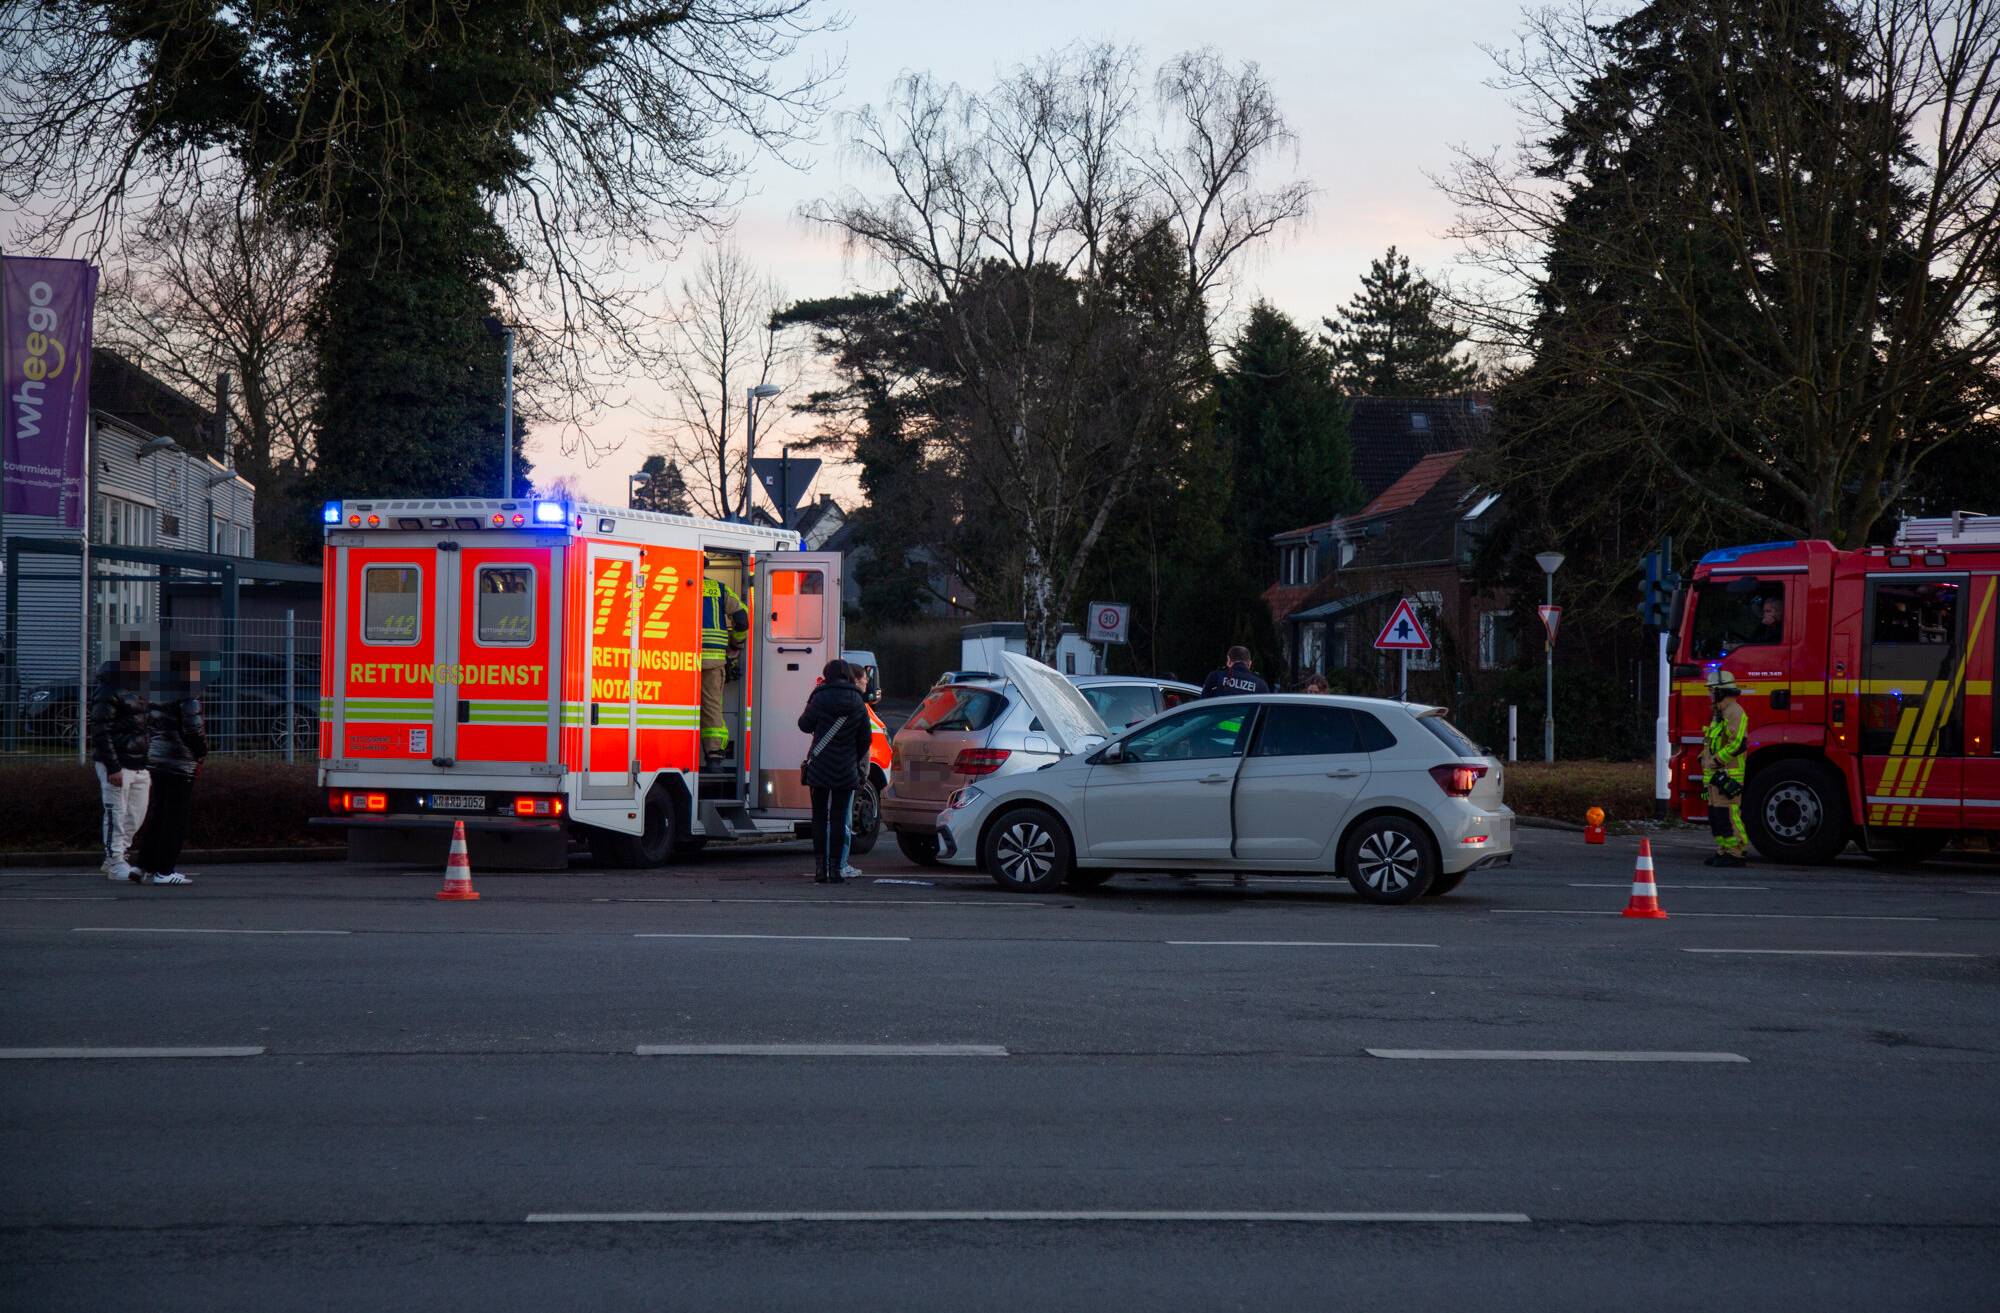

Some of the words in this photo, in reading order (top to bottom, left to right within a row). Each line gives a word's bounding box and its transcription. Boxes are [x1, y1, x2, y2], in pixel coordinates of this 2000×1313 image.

[12, 281, 58, 439] wheego
[593, 560, 680, 639] 112
[384, 615, 417, 638] 112
[496, 615, 529, 638] 112
[1103, 613, 1115, 624] 30
[350, 662, 544, 686] RETTUNGSDIENST
[1222, 676, 1257, 693] POLIZEI
[592, 678, 662, 701] NOTARZT
[463, 797, 485, 808] 1052
